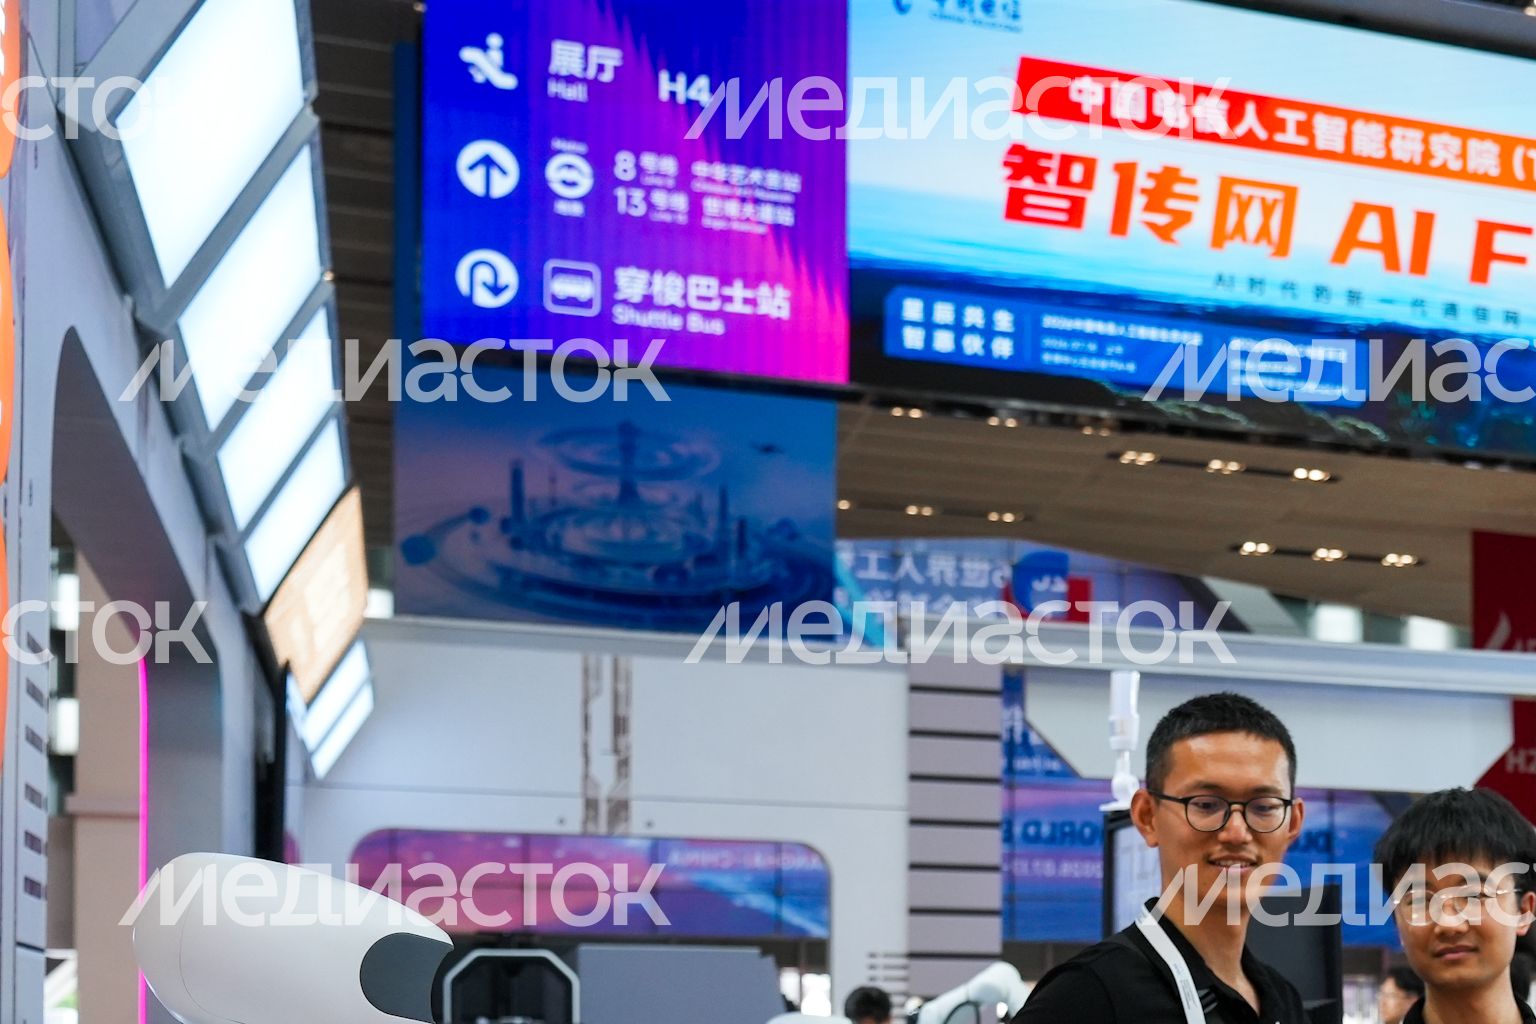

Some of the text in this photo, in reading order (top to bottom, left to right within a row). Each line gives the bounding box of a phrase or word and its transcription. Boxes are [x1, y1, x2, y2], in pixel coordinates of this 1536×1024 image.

[548, 39, 714, 108] 展厅 H4
[1002, 142, 1299, 260] 智传网
[1330, 200, 1436, 277] AI
[611, 303, 726, 336] Shuttle Bus
[614, 265, 792, 321] 穿梭巴士站
